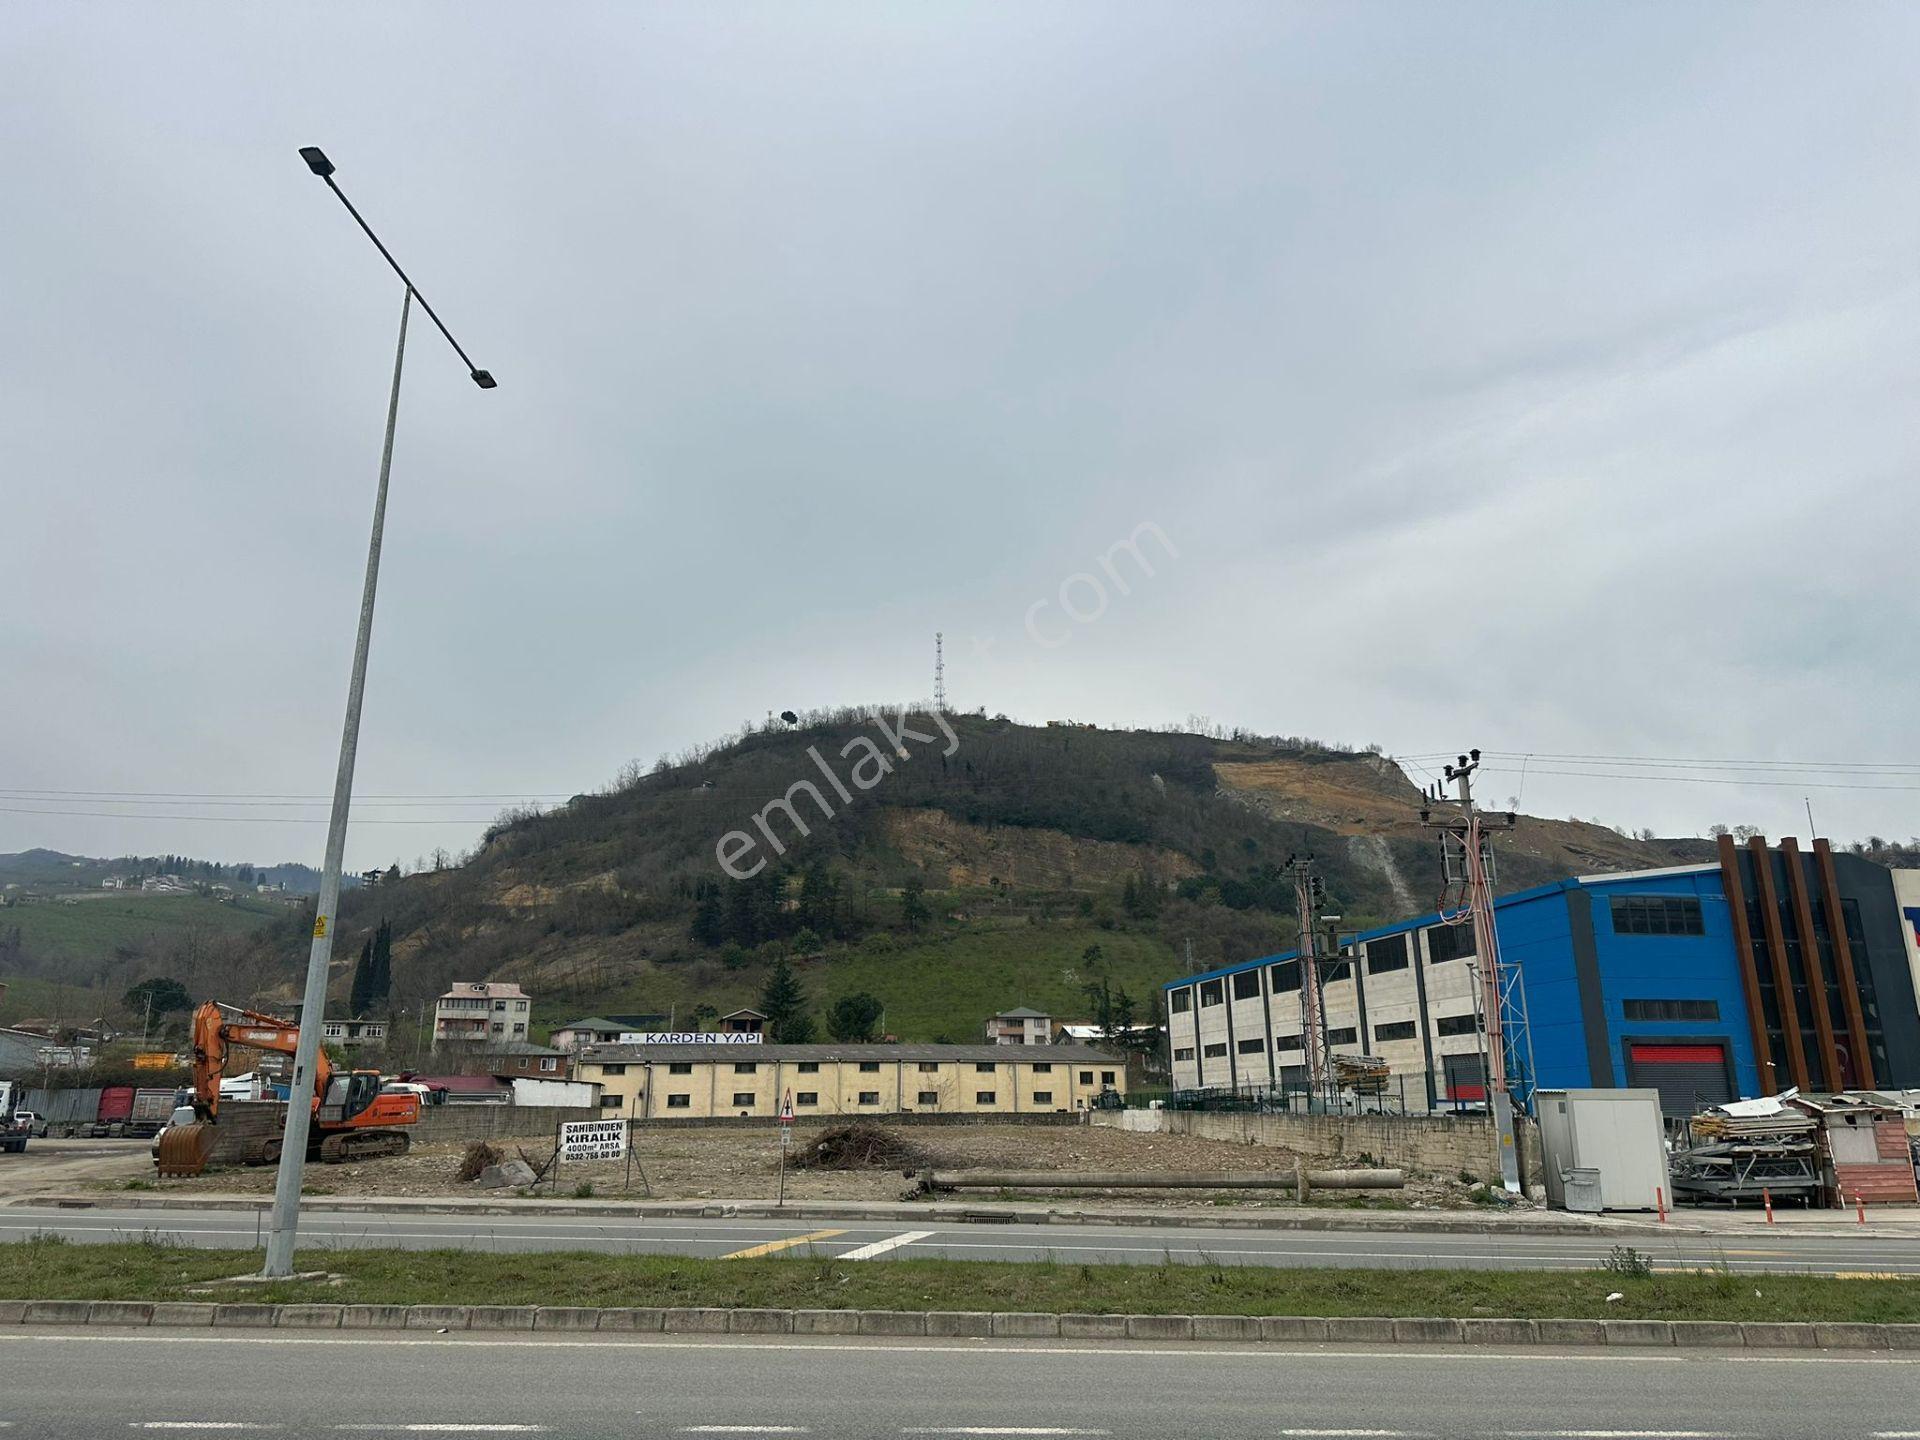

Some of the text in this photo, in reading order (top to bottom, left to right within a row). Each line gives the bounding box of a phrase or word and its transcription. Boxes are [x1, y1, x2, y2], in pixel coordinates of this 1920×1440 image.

[646, 1033, 760, 1043] KARDEN YAPI
[600, 1142, 620, 1150] ARSA
[566, 1153, 583, 1161] 0532
